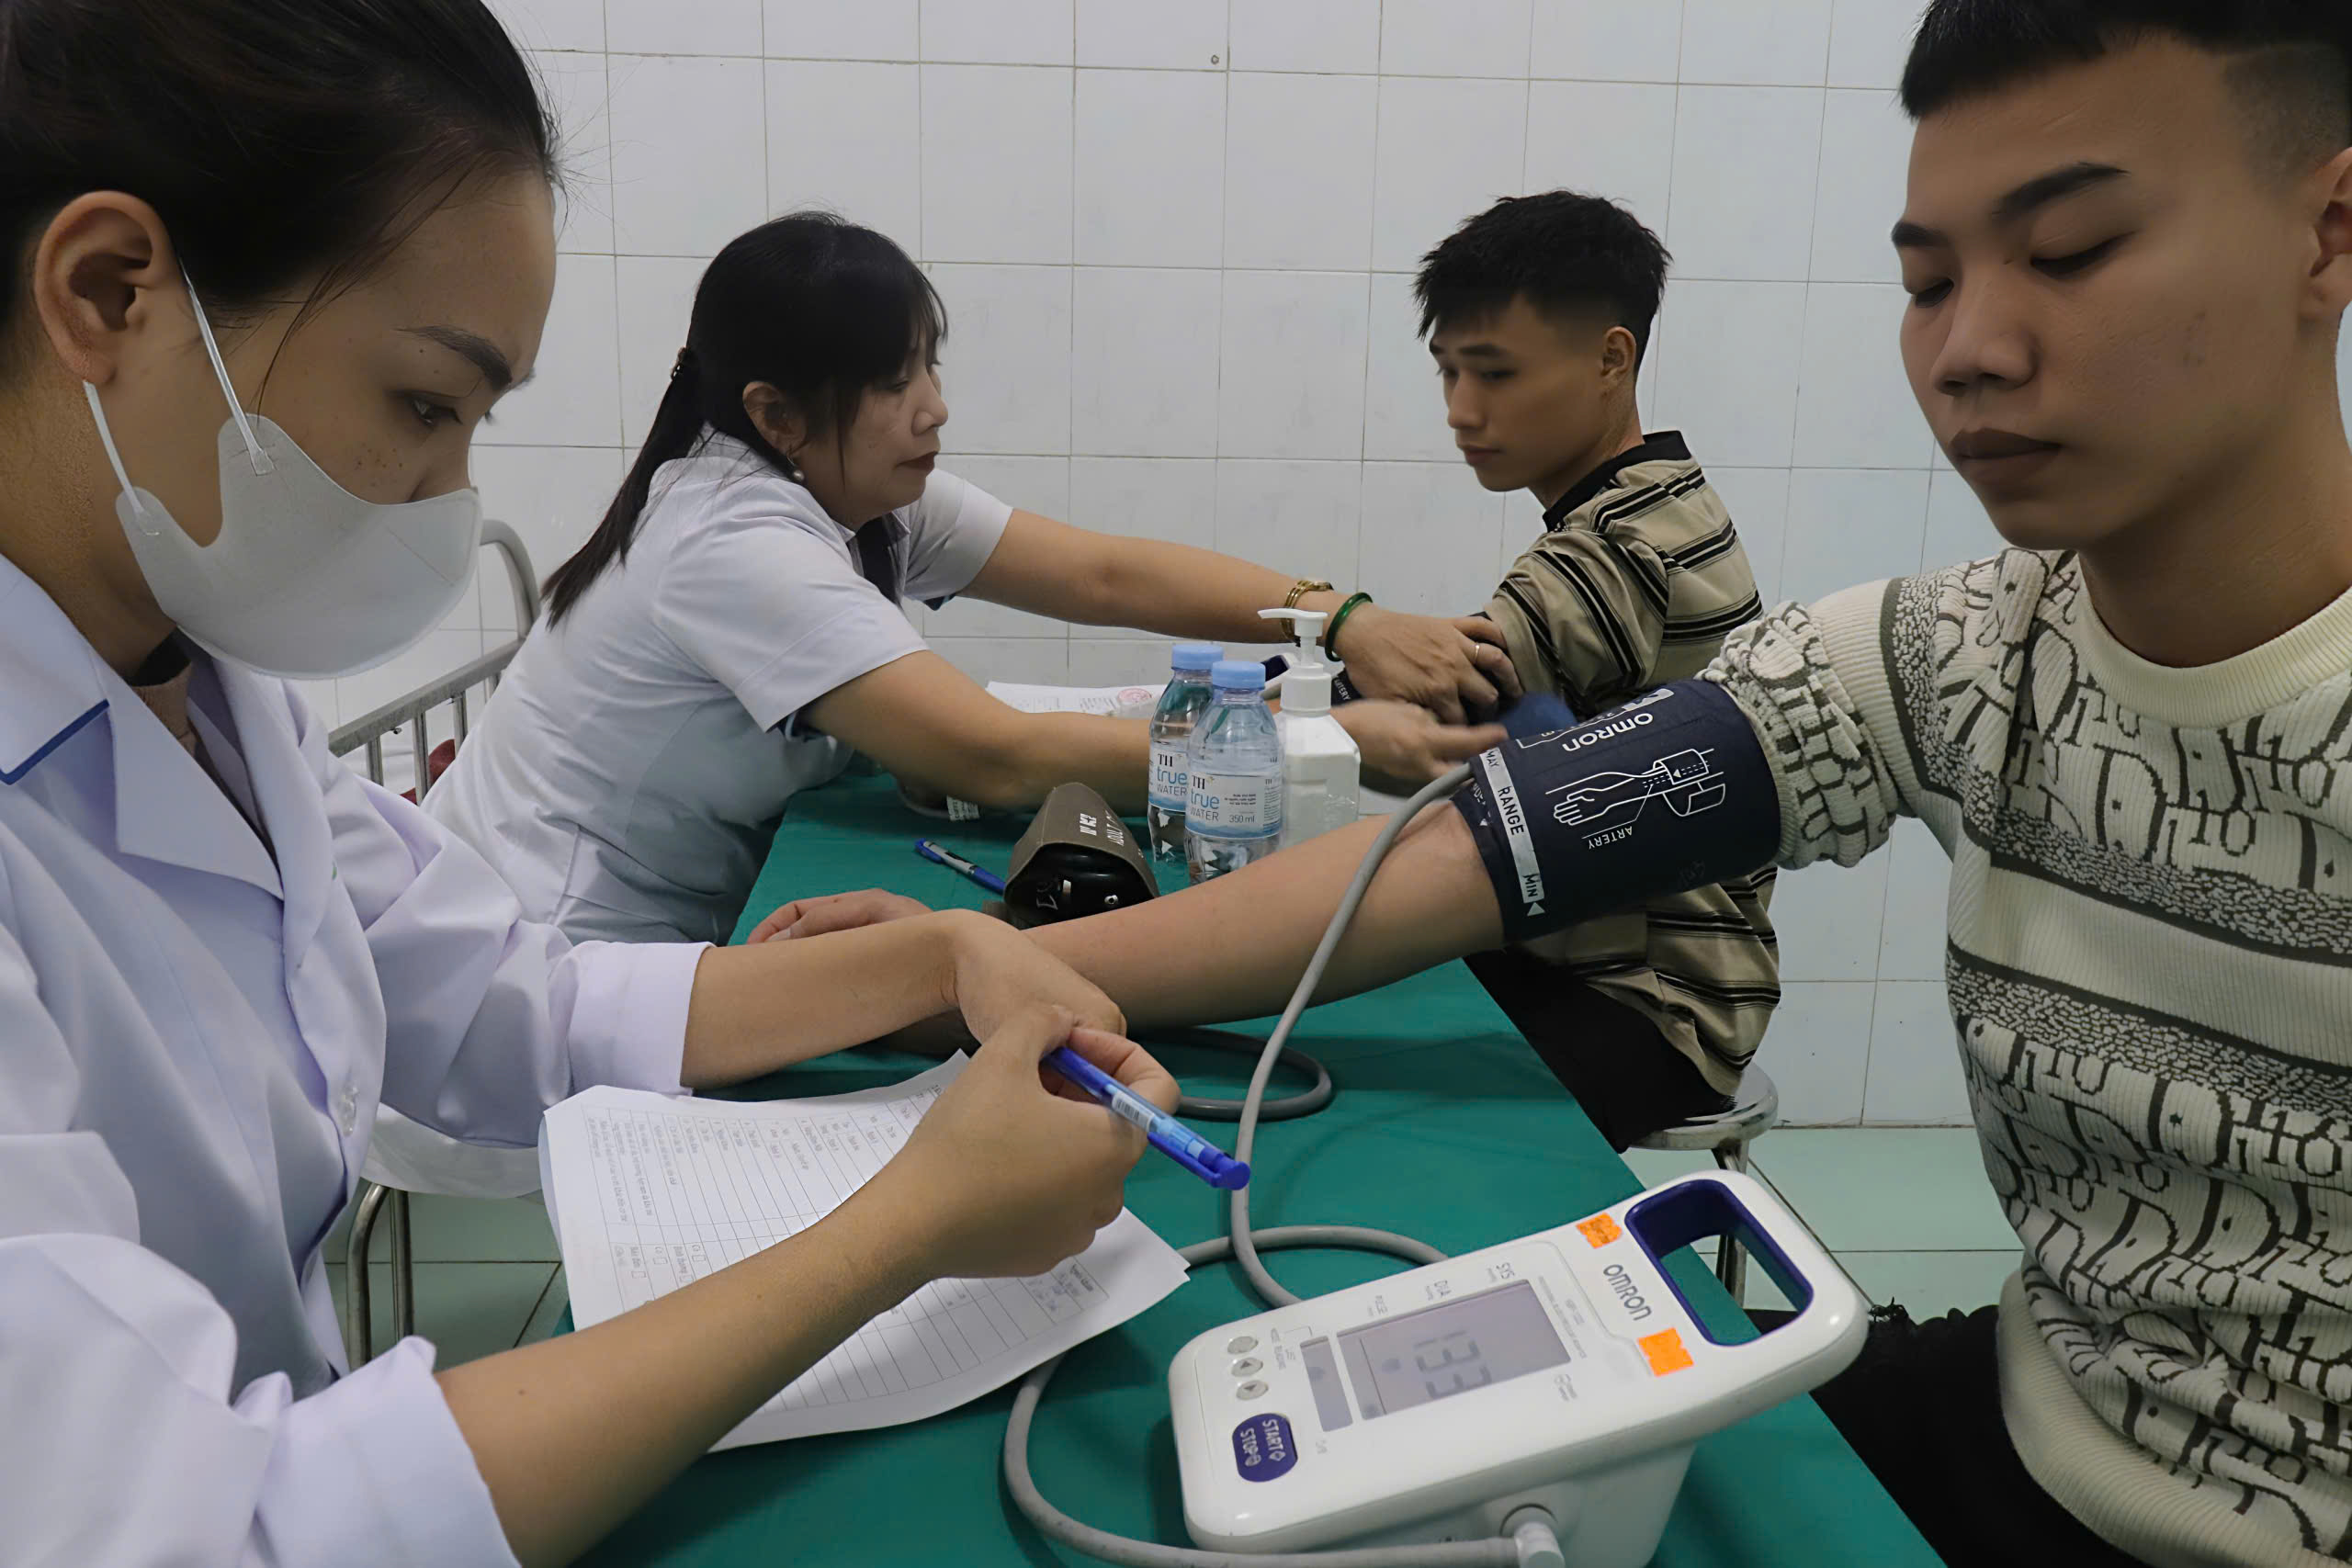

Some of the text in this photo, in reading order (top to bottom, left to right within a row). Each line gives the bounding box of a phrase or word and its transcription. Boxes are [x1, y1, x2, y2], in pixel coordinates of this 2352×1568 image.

[1157, 766, 1188, 785] true
[1157, 784, 1188, 796] WATER
[1191, 789, 1220, 810] true
[1191, 808, 1219, 822] WATER
[1229, 815, 1255, 823] 350 ml
[1498, 786, 1525, 835] RANGE
[1522, 874, 1541, 897] MIN
[1589, 826, 1633, 850] ARTERY
[1240, 1427, 1259, 1455] STOP
[1262, 1419, 1283, 1450] START
